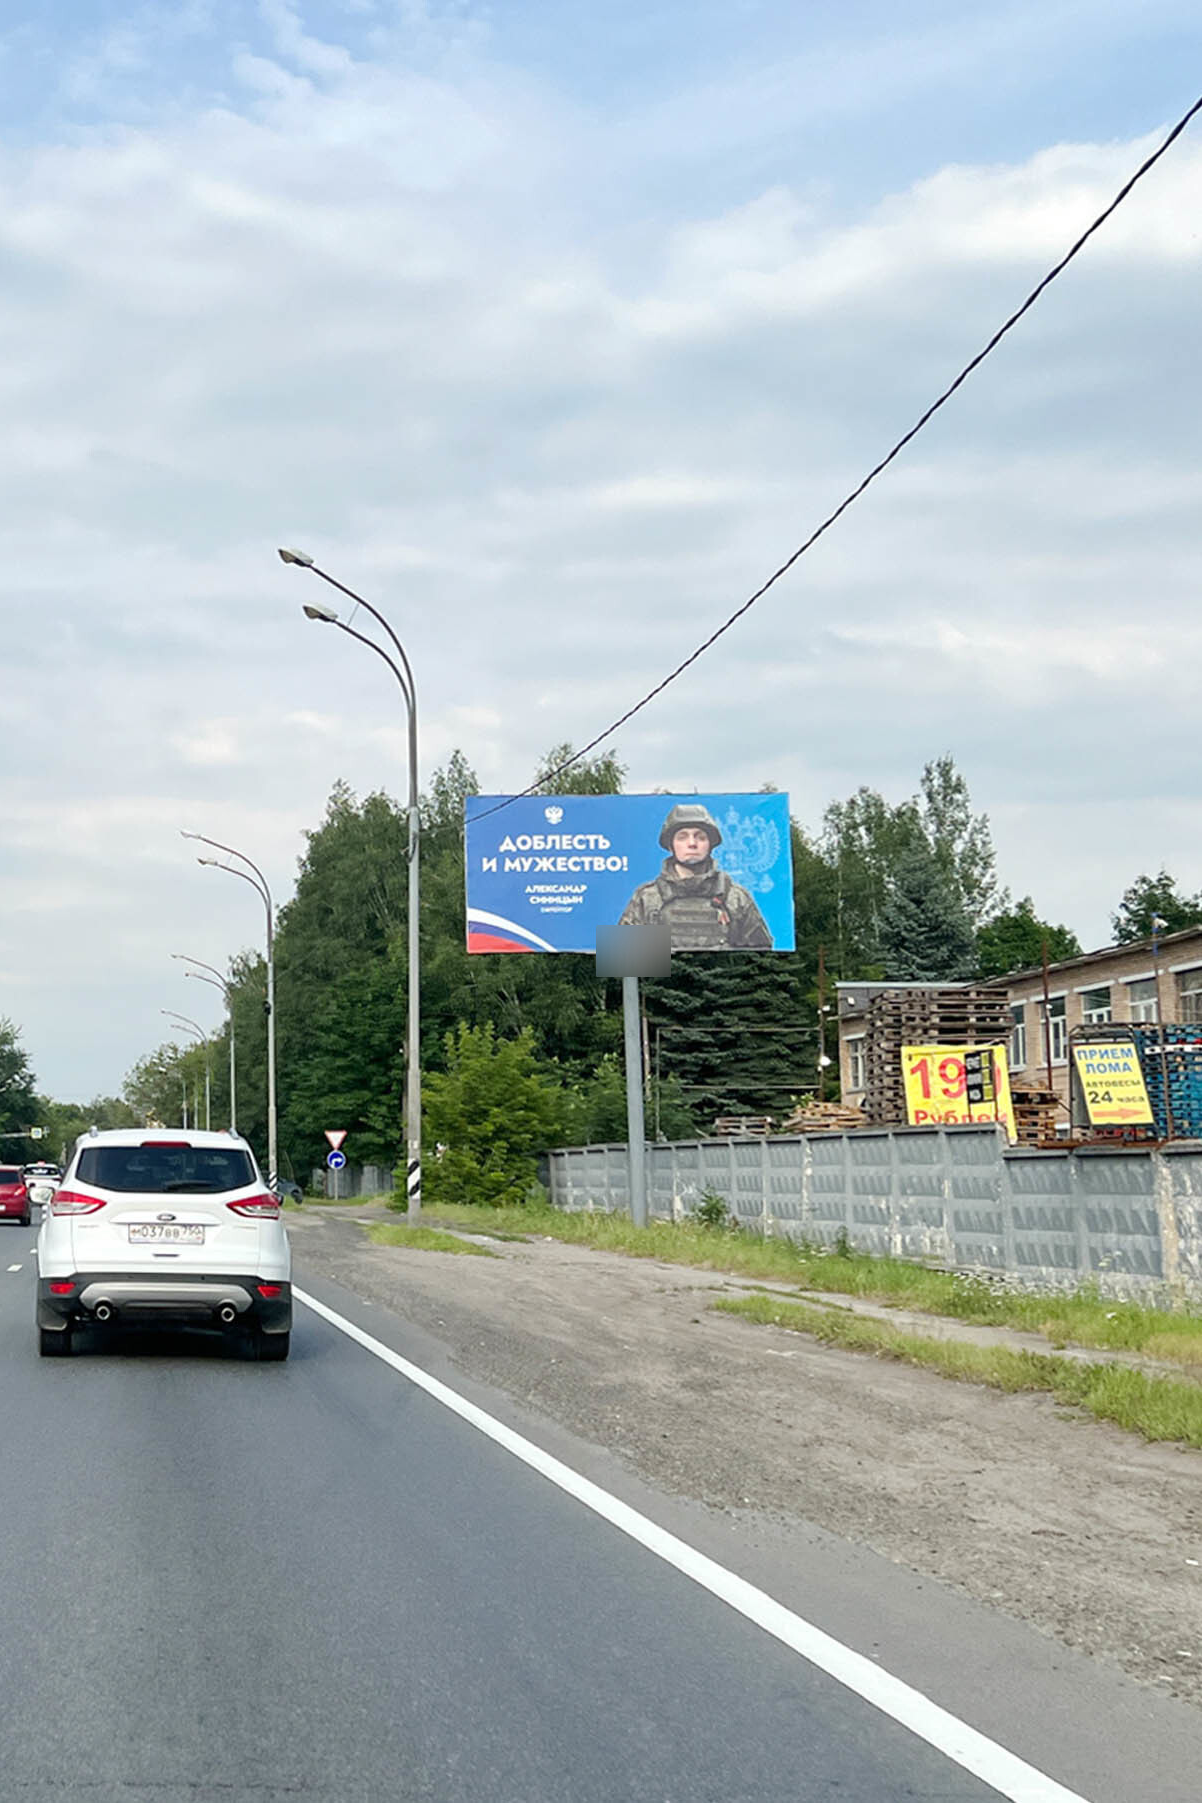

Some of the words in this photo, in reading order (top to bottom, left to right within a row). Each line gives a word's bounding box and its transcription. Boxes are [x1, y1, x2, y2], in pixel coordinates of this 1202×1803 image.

[499, 834, 611, 852] ДОБЛЕСТЬ
[482, 857, 498, 872] И
[504, 856, 628, 872] МУЖЕСТВО!
[525, 884, 587, 894] АЛЕКСАНДР
[1077, 1048, 1133, 1060] ПРИЕМ
[1085, 1062, 1132, 1074] ЛОМА
[1088, 1090, 1113, 1104] 24
